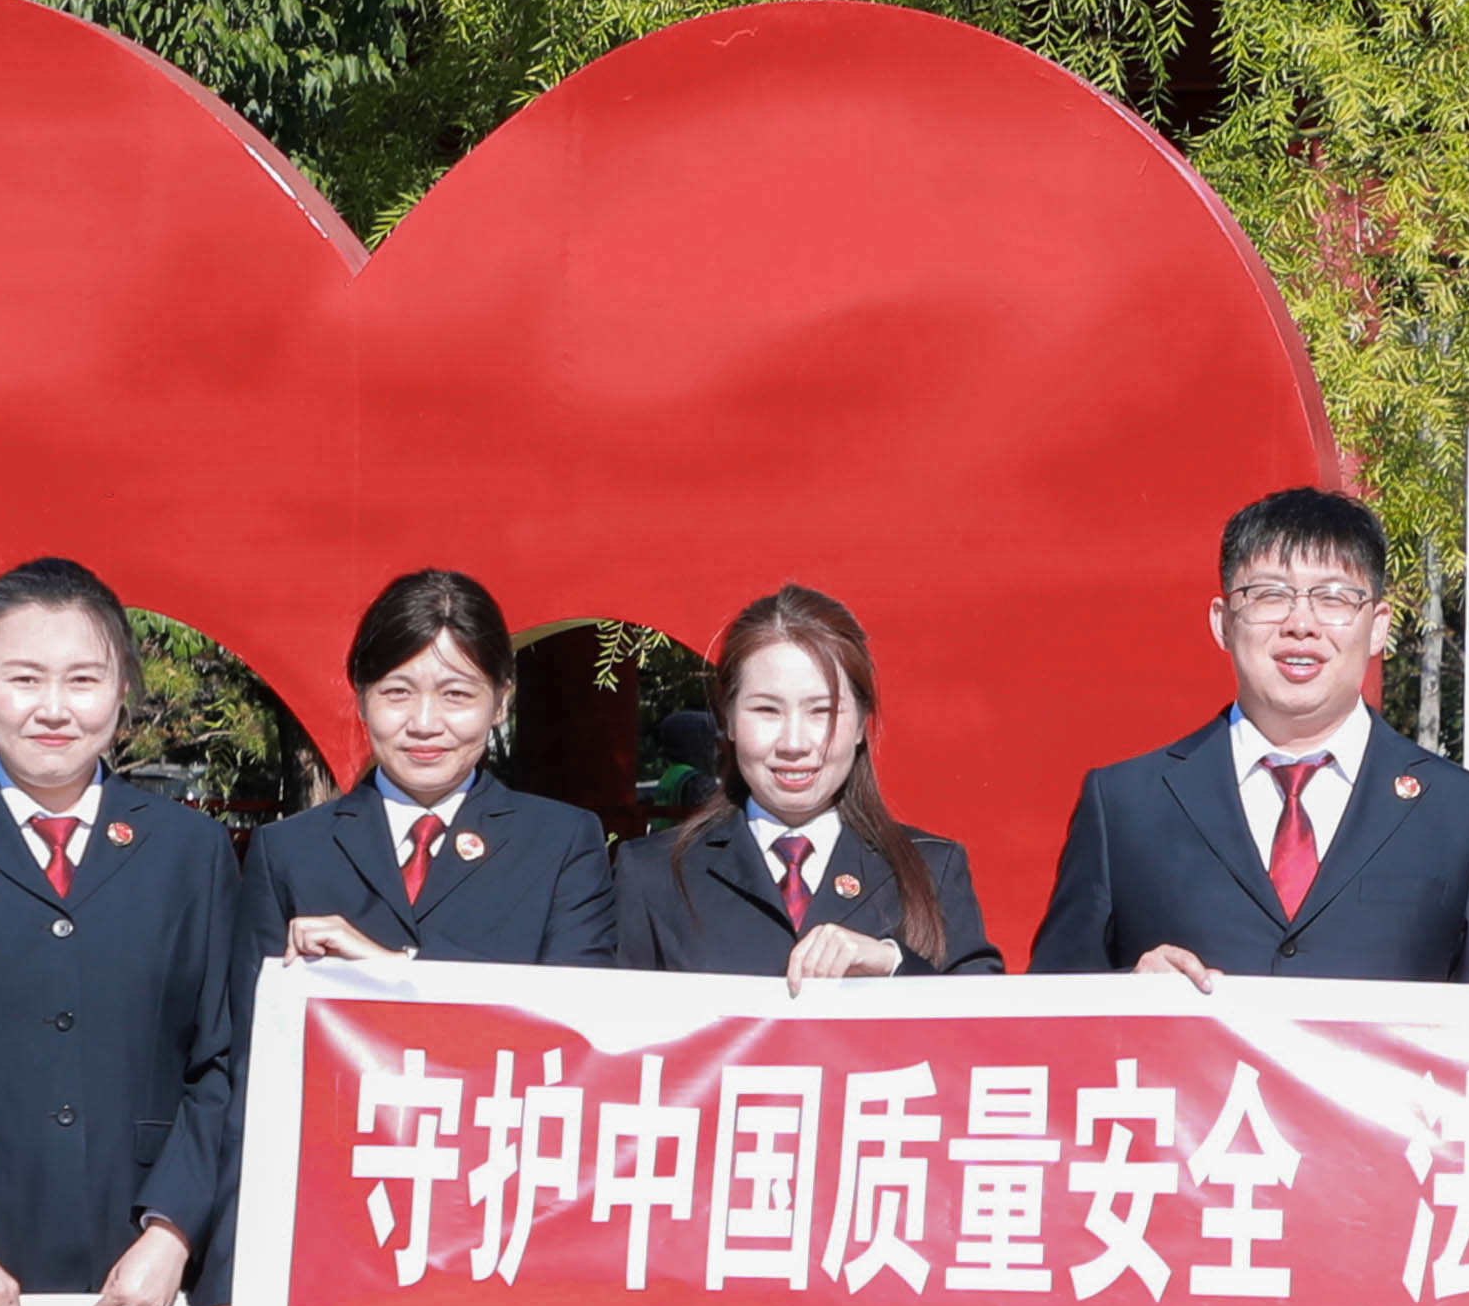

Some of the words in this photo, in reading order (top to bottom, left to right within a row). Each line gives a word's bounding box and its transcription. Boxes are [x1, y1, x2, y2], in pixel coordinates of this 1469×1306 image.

[352, 1048, 1302, 1302] 守护中国质量安全
